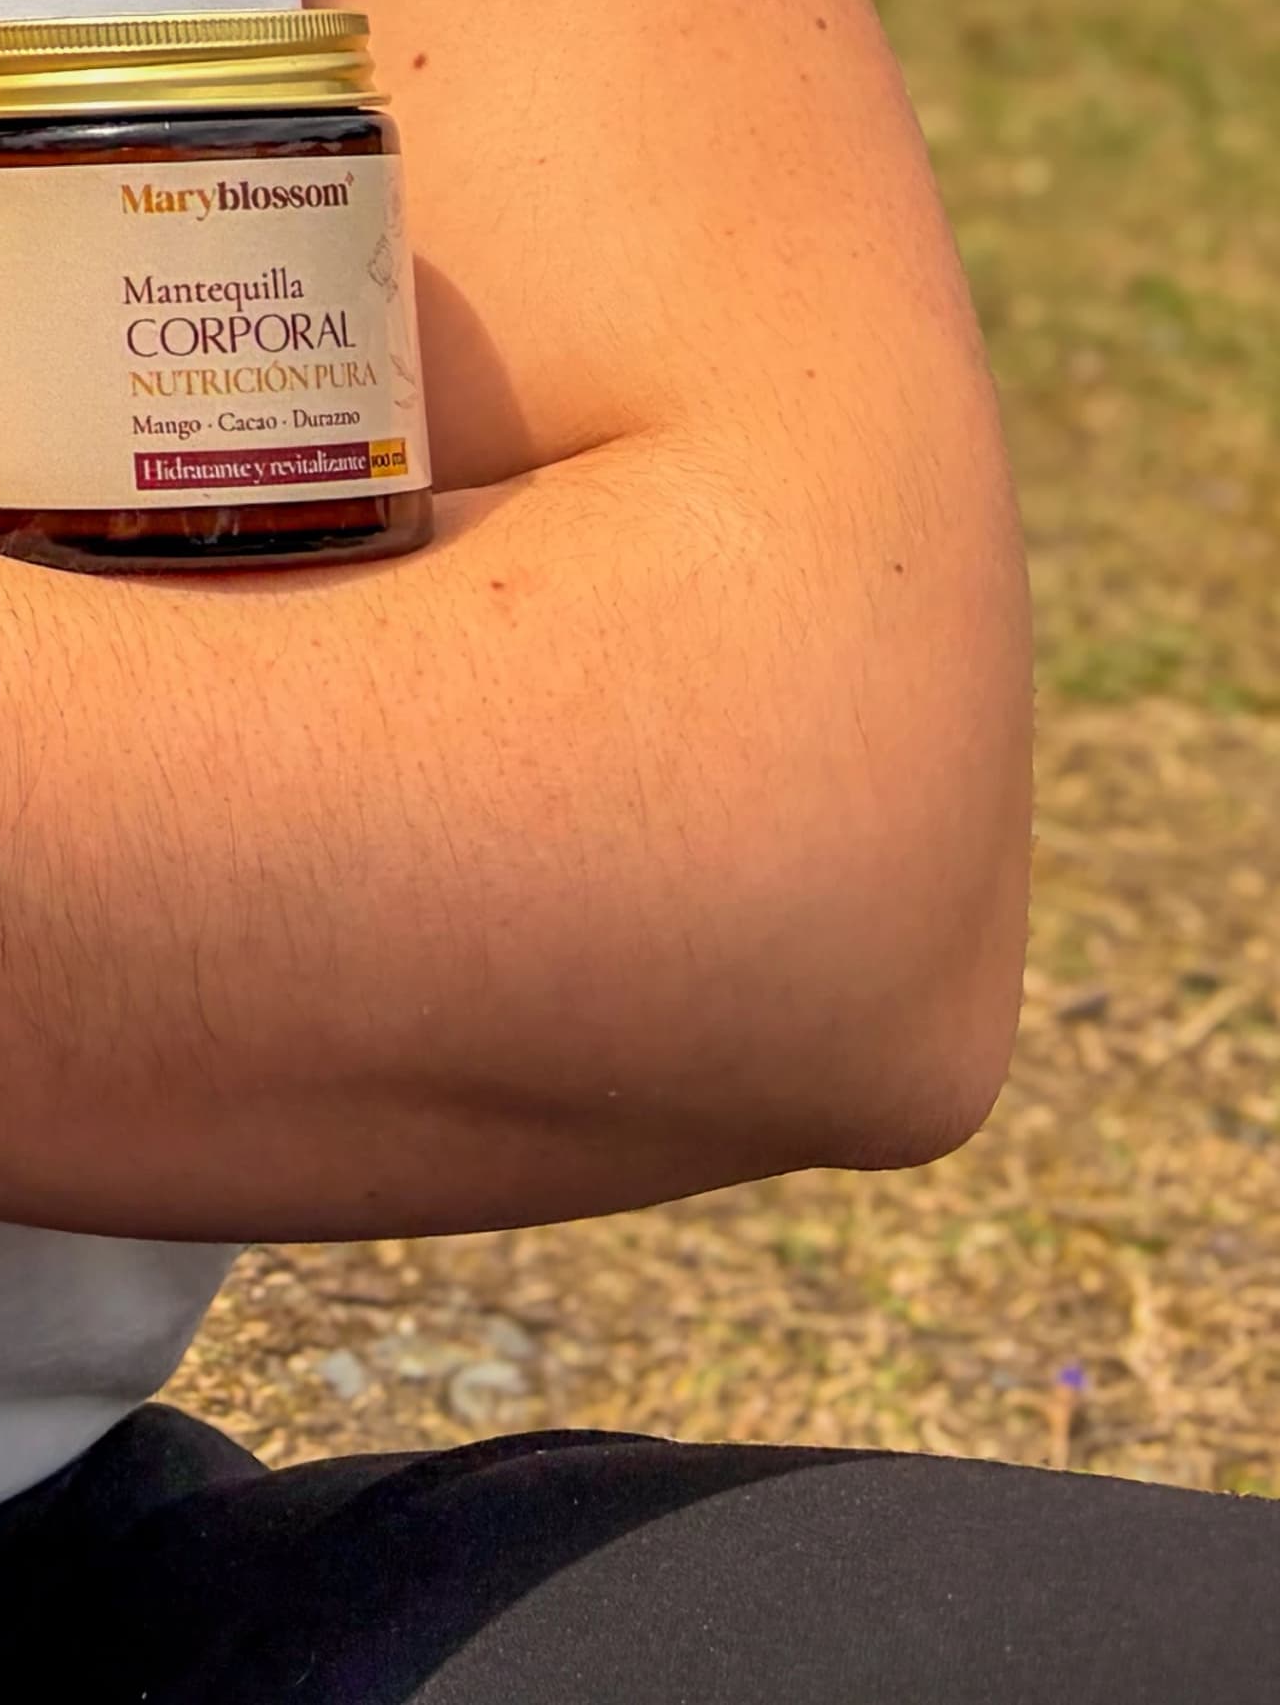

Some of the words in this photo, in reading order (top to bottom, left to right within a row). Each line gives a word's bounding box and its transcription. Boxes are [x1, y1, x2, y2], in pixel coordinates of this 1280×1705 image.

[121, 267, 305, 313] Mantequilla
[126, 310, 357, 359] CORPORAL
[128, 360, 311, 398] NUTRICIÓN
[315, 360, 378, 390] PURA
[131, 415, 202, 441] Mango
[217, 412, 278, 433] Cacao
[292, 408, 361, 429] Durazno
[142, 454, 252, 481] Hidratante
